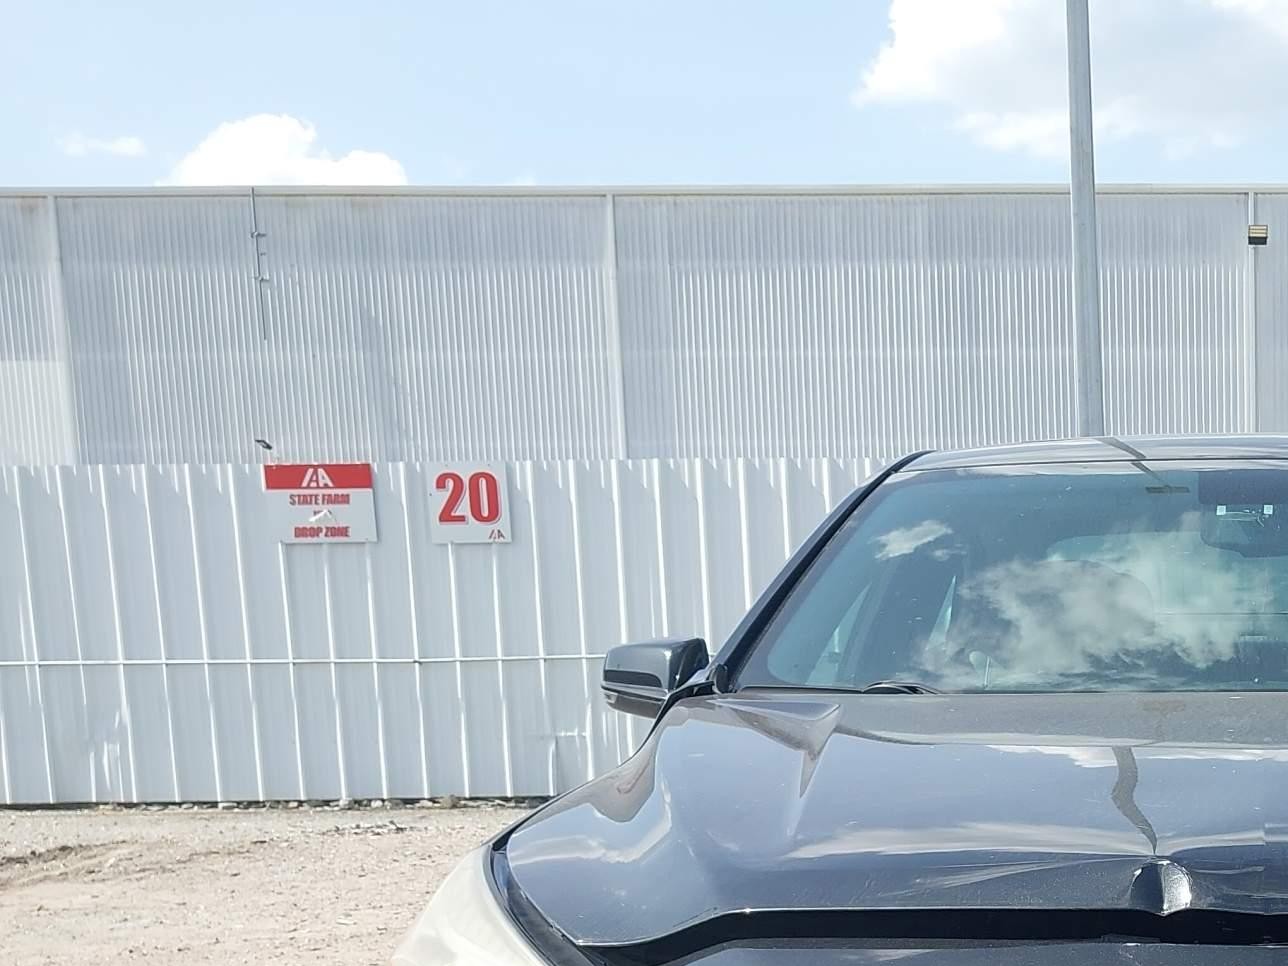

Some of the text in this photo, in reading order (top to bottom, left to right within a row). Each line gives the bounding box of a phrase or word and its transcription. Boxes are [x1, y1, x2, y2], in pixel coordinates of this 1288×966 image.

[289, 494, 350, 506] STATE FARM
[435, 472, 501, 525] 20
[294, 526, 350, 538] DROP ZONE
